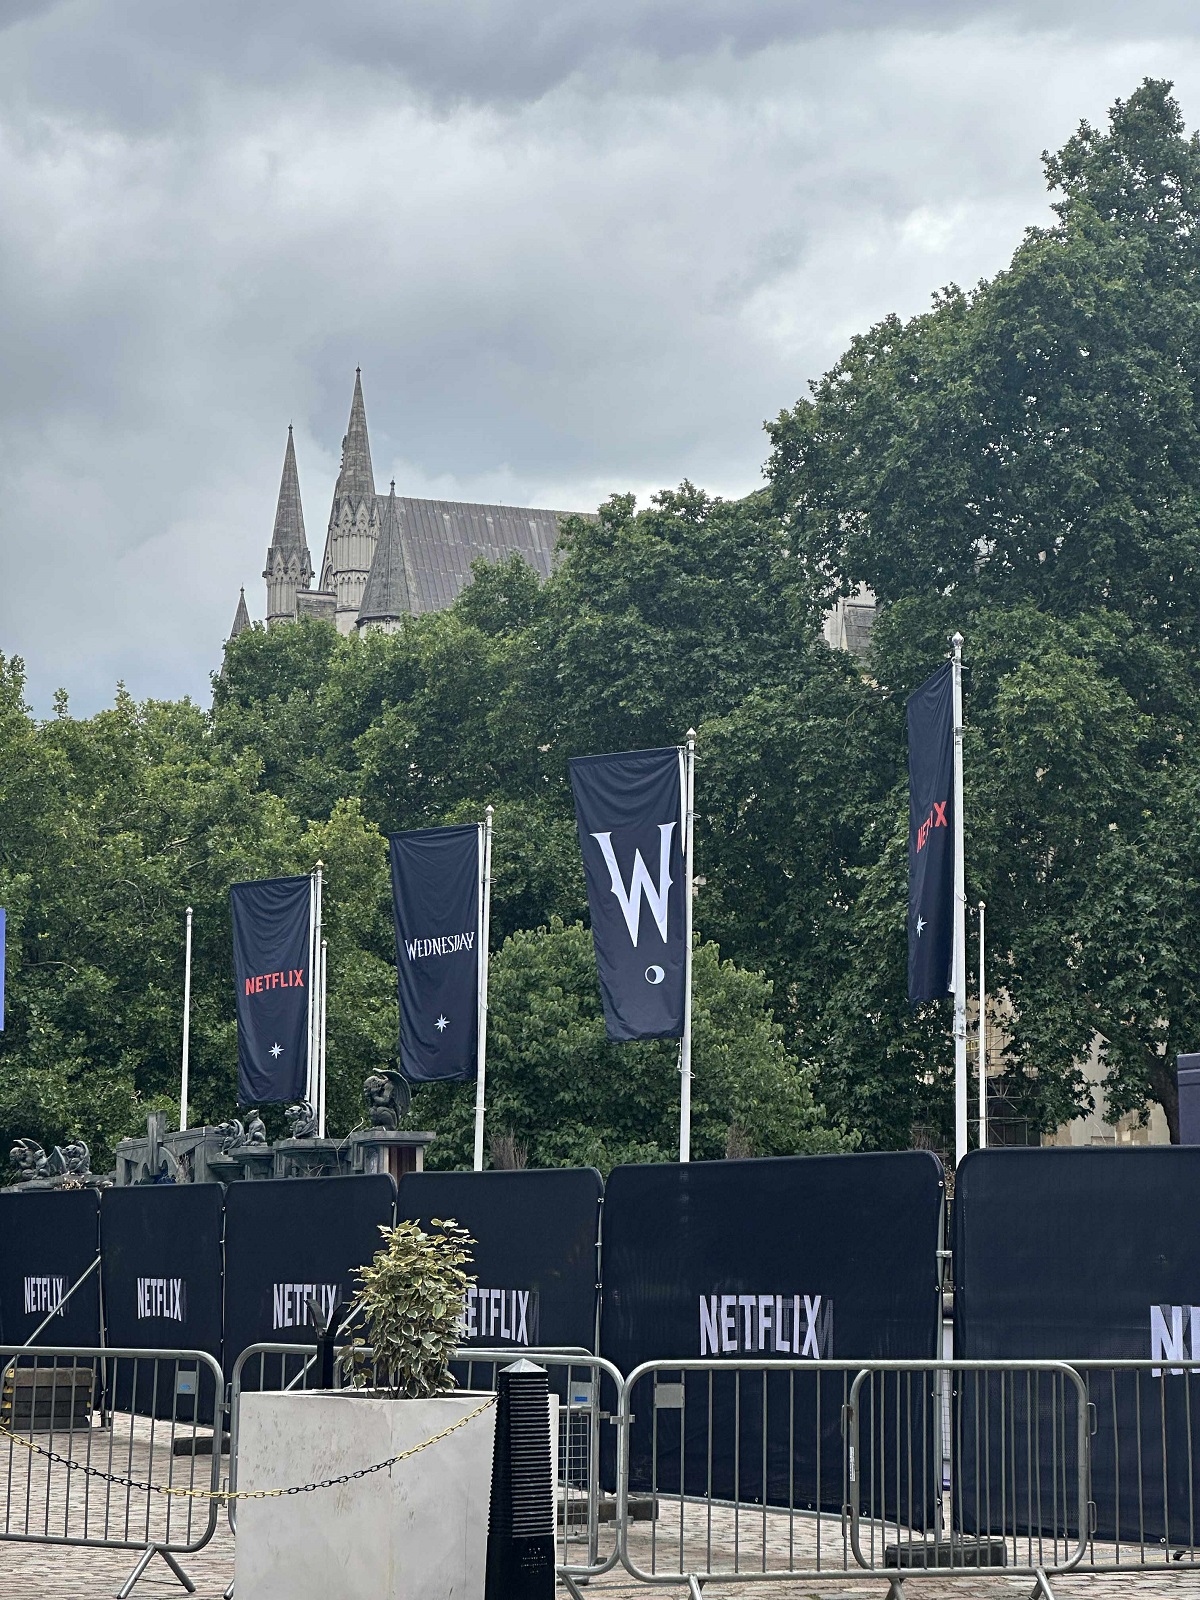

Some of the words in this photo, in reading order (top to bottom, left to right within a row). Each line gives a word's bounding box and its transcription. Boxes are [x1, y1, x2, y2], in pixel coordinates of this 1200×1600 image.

[589, 822, 677, 947] W
[404, 931, 475, 961] WEDNESDAY
[245, 969, 304, 996] NETFLIX
[136, 1277, 182, 1322] NETFLIX
[699, 1294, 822, 1360] NETFLIX
